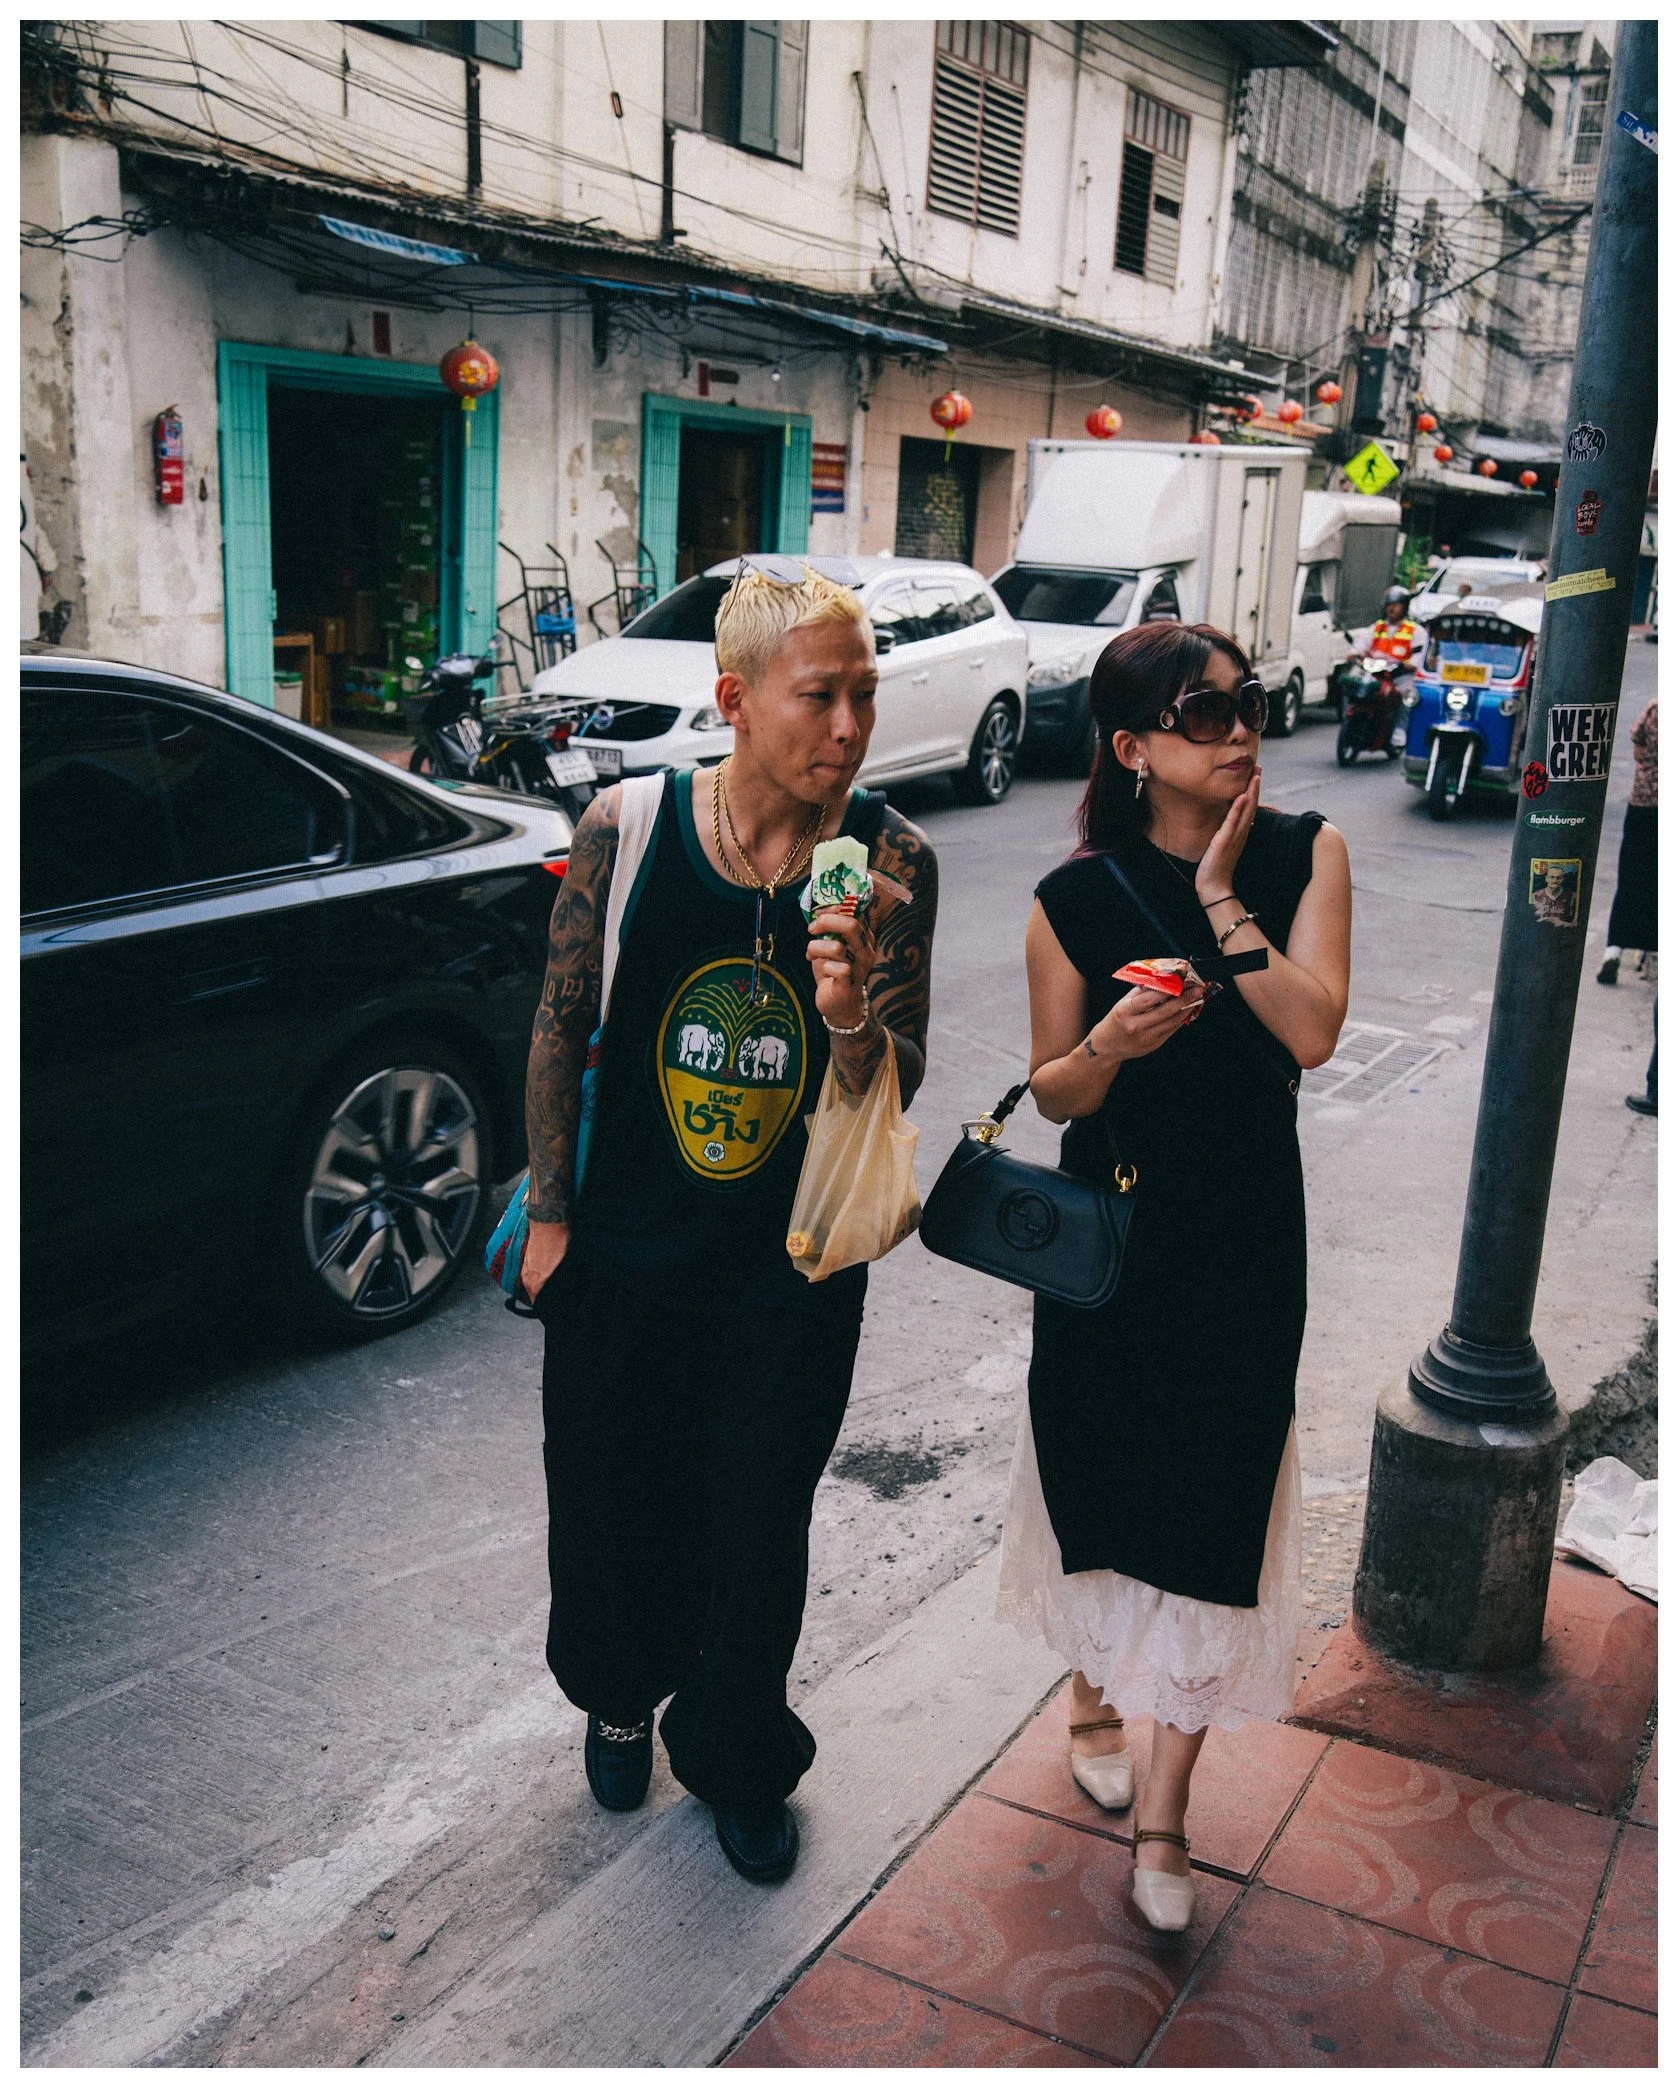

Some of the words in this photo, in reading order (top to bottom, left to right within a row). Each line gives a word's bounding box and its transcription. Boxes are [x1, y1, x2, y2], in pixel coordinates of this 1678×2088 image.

[708, 1089, 744, 1106] เบียร์
[683, 1100, 760, 1144] ช้าง
